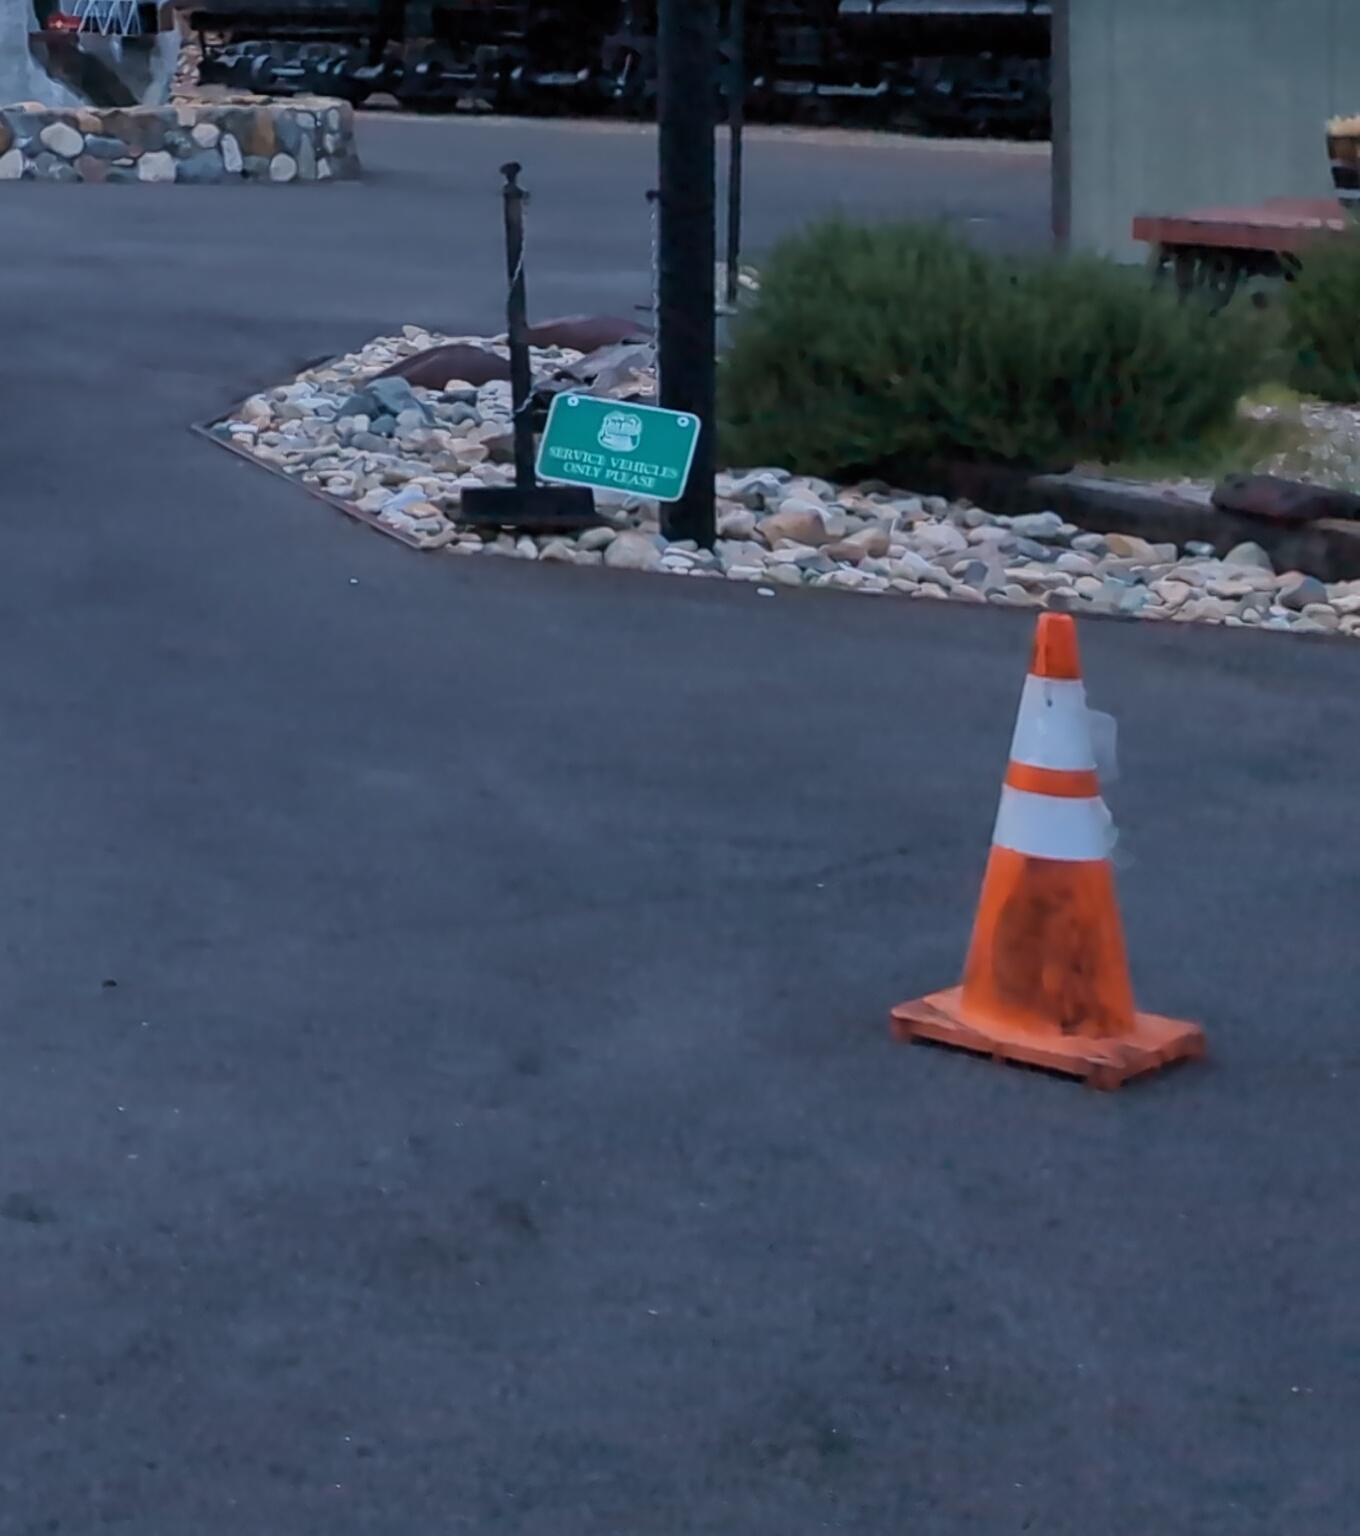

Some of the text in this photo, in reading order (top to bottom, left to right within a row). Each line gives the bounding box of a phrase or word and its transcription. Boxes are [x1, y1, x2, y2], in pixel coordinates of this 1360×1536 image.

[549, 446, 678, 478] SERVICE VEHICLES
[563, 462, 656, 488] ONLY PLEASE
